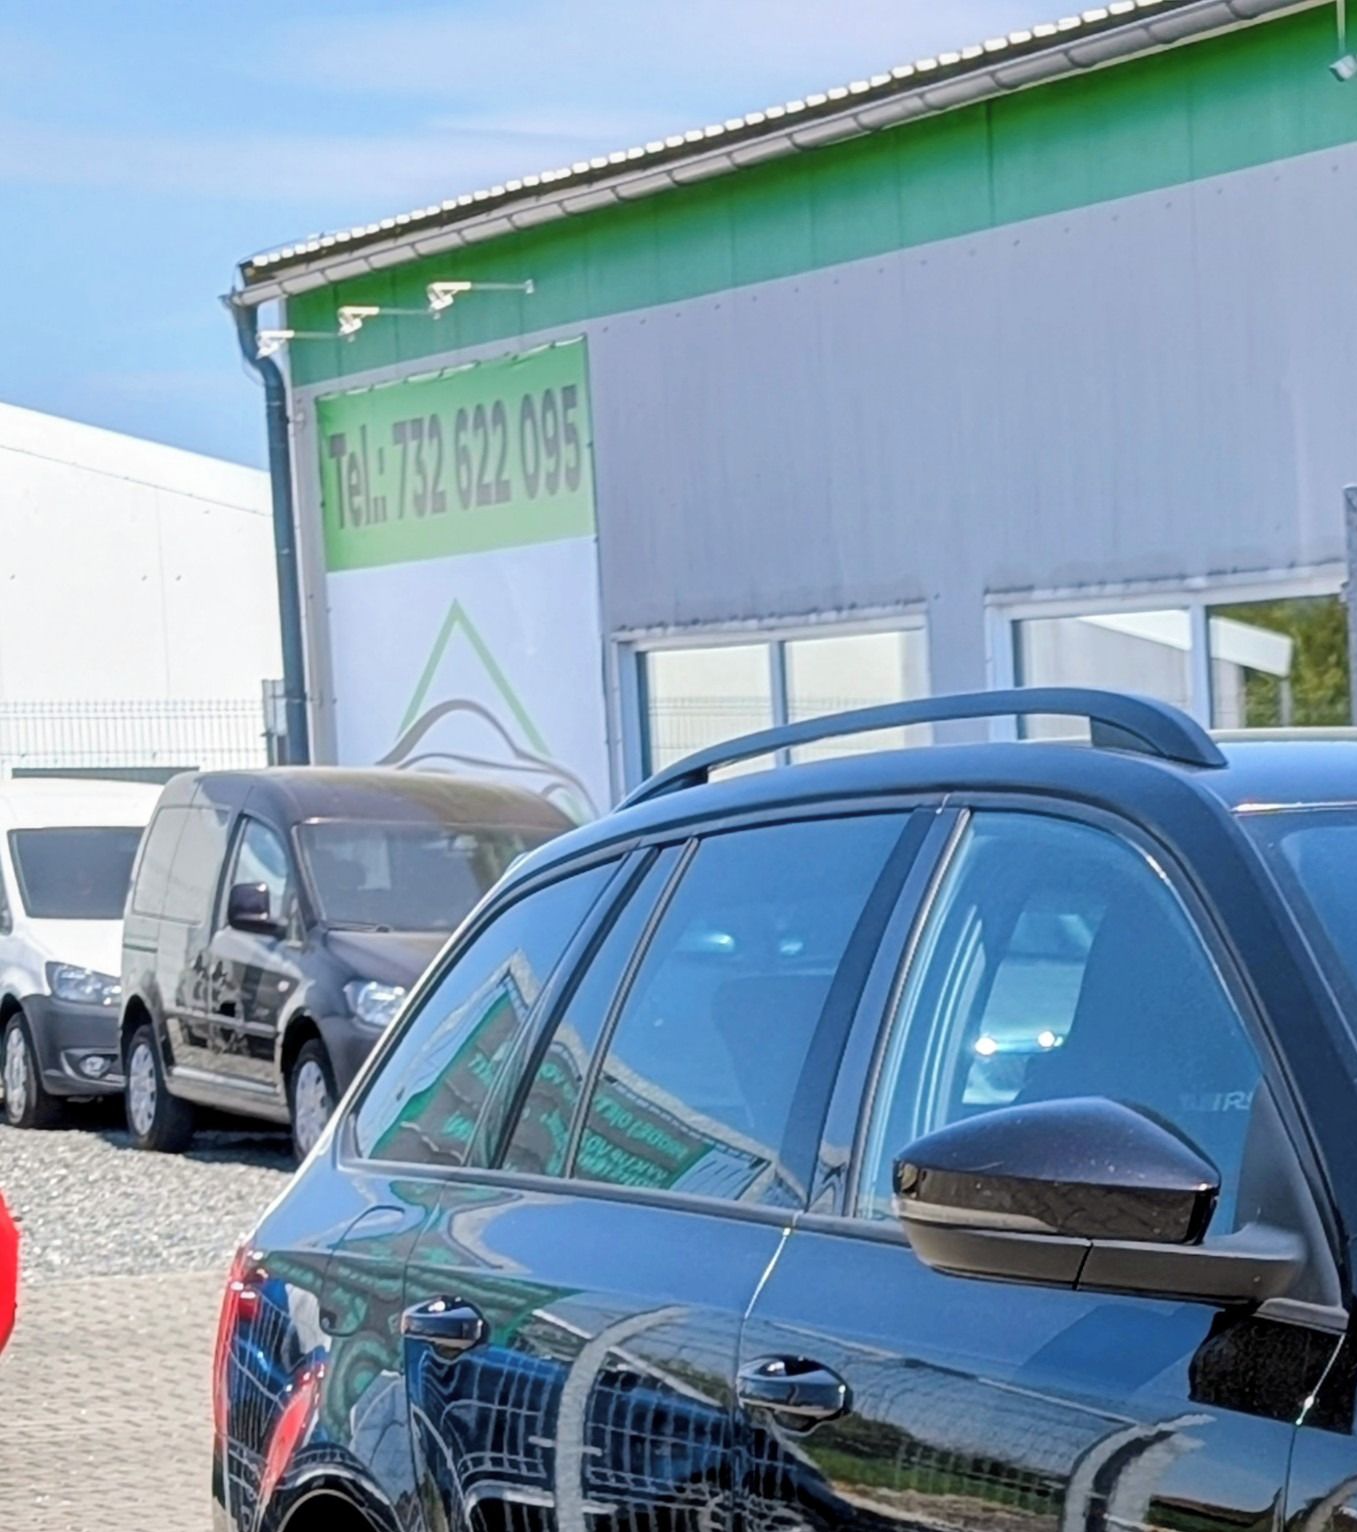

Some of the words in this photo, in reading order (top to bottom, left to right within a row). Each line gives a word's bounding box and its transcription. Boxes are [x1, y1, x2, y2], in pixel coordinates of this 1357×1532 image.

[329, 423, 387, 529] Tel.:
[392, 413, 447, 520] 732
[454, 399, 512, 510] 622
[520, 384, 582, 499] 095
